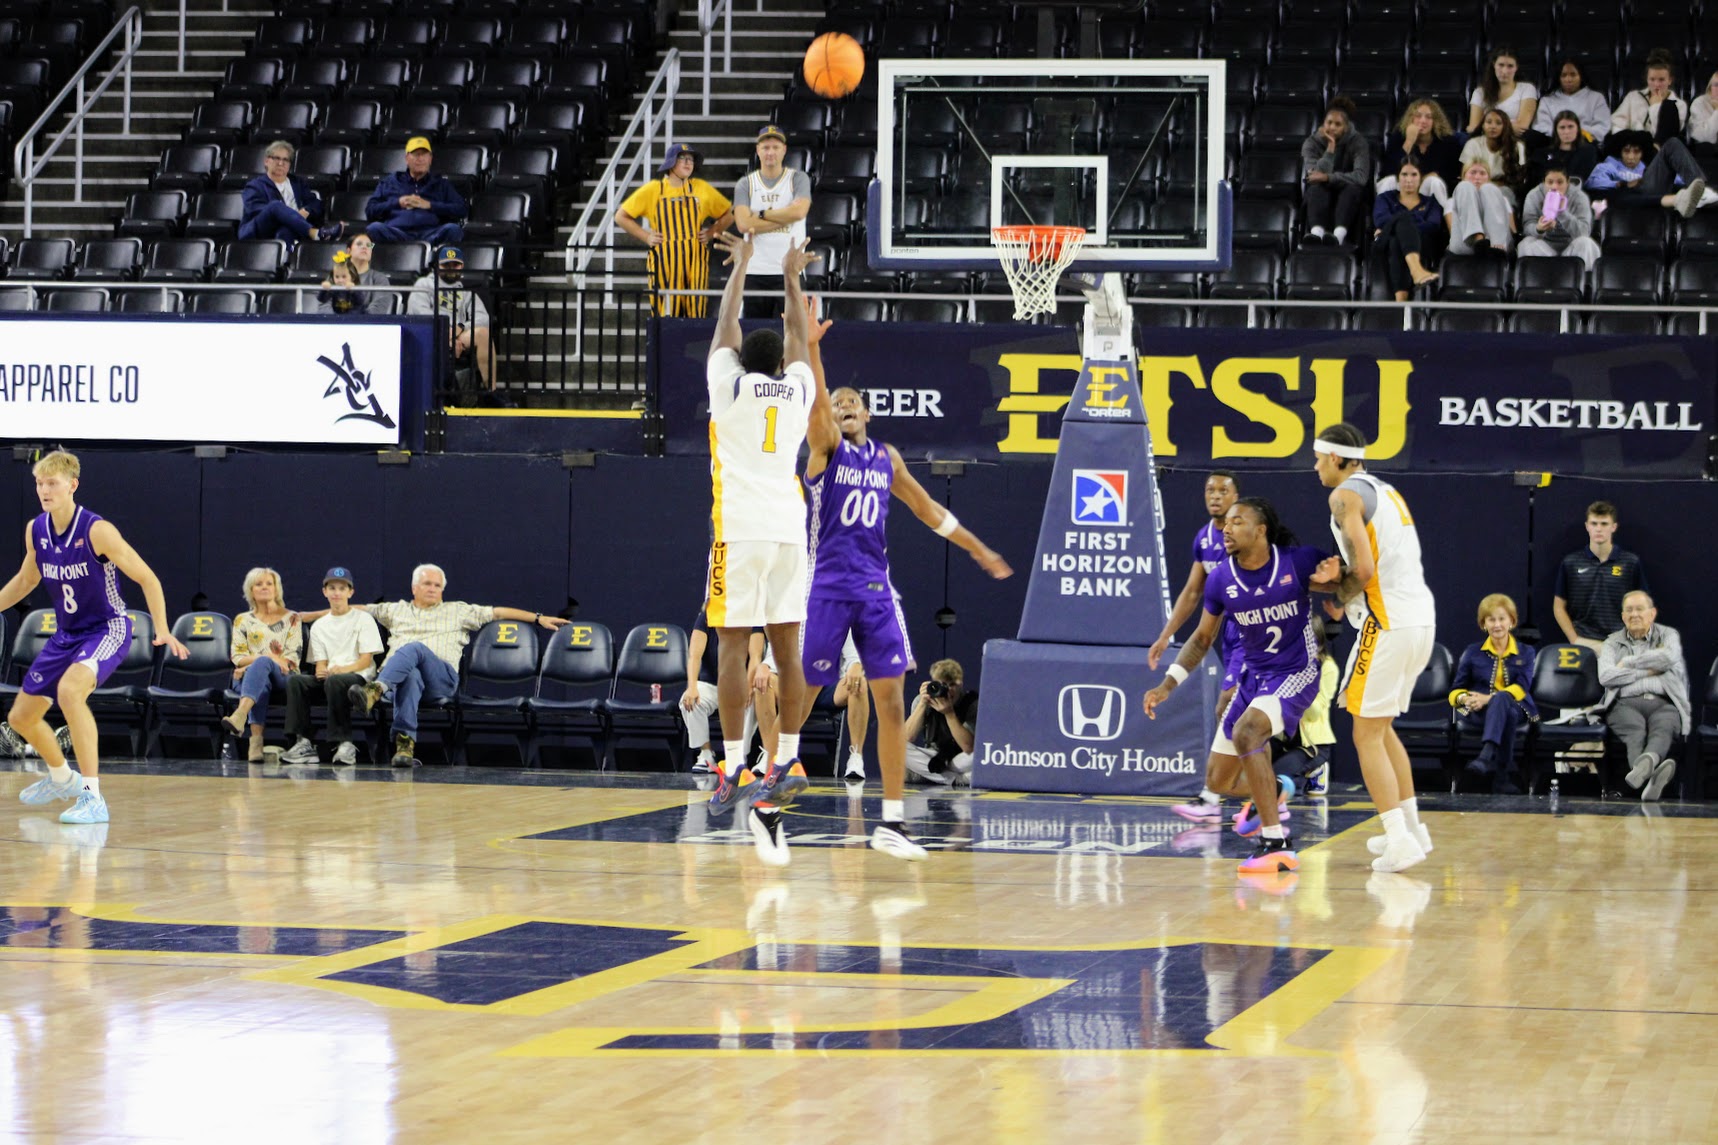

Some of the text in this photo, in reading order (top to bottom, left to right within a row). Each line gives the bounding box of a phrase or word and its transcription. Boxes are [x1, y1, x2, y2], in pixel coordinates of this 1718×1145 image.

[0, 364, 139, 403] APPAREL CO
[754, 382, 794, 402] COOPER
[1085, 367, 1130, 409] E
[1439, 396, 1703, 431] BASKETBALL
[762, 406, 778, 453] 1
[835, 464, 888, 490] HIGH POINT
[840, 489, 879, 529] 00
[1064, 531, 1131, 551] FIRST
[42, 561, 90, 581] HIGH POINT
[1042, 553, 1152, 575] HORIZON
[1612, 566, 1623, 576] E
[62, 583, 78, 614] 8
[1060, 577, 1132, 597] BANK
[1234, 600, 1299, 626] HIGH POINT
[192, 616, 214, 636] E
[496, 623, 518, 644] E
[571, 626, 593, 646] E
[646, 627, 669, 647] E
[1264, 625, 1283, 654] 2
[1356, 621, 1378, 676] BUCS
[1558, 648, 1581, 669] E
[981, 742, 1196, 777] Johnson City Honda
